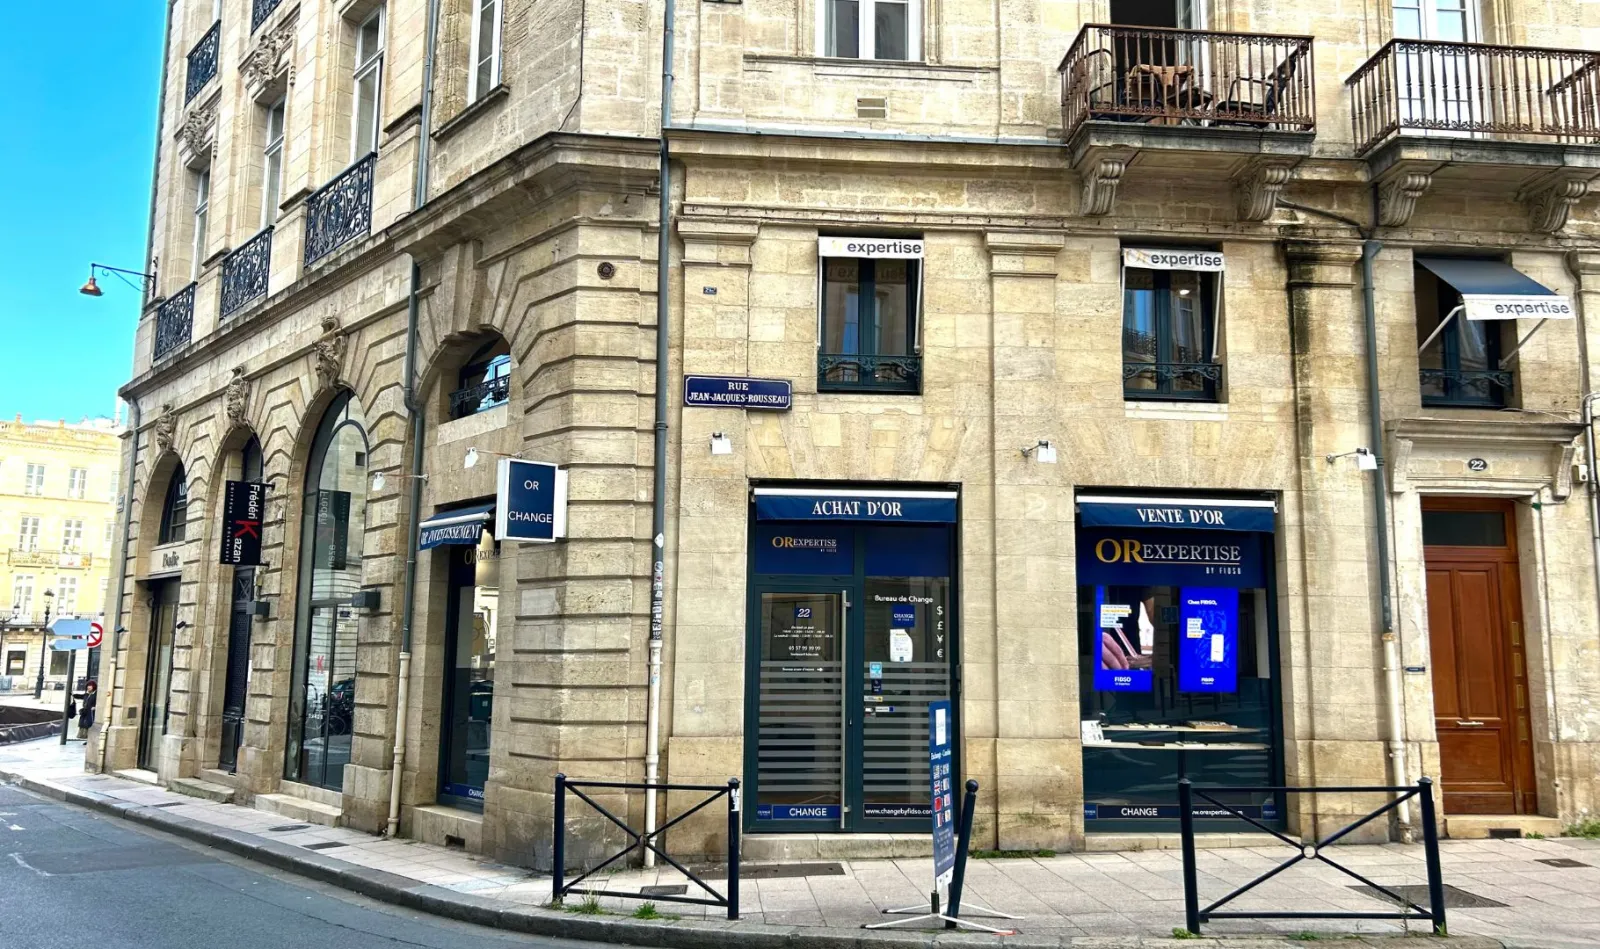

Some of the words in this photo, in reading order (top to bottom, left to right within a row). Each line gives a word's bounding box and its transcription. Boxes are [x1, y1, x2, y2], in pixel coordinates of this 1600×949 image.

[847, 242, 922, 256] expertise
[1151, 253, 1222, 267] expertise
[1495, 302, 1570, 316] expertise
[727, 381, 749, 391] RUE
[688, 391, 788, 404] JEAN-JACQUES-ROUSSEAU
[1471, 460, 1484, 470] 22
[524, 480, 540, 491] OR
[812, 501, 861, 516] ACHAT
[867, 501, 903, 517] D'OR
[508, 511, 553, 523] CHANGE
[1137, 508, 1185, 523] VENTE
[1190, 509, 1226, 525] D'OR
[874, 594, 898, 602] Bureau
[898, 595, 907, 603] de
[908, 595, 934, 604] Change
[797, 608, 811, 618] 22
[936, 605, 944, 616] $
[936, 620, 944, 630] £
[936, 634, 944, 644] ¥
[936, 648, 944, 658] €
[788, 807, 828, 817] CHANGE
[1120, 802, 1159, 816] CHANGE
